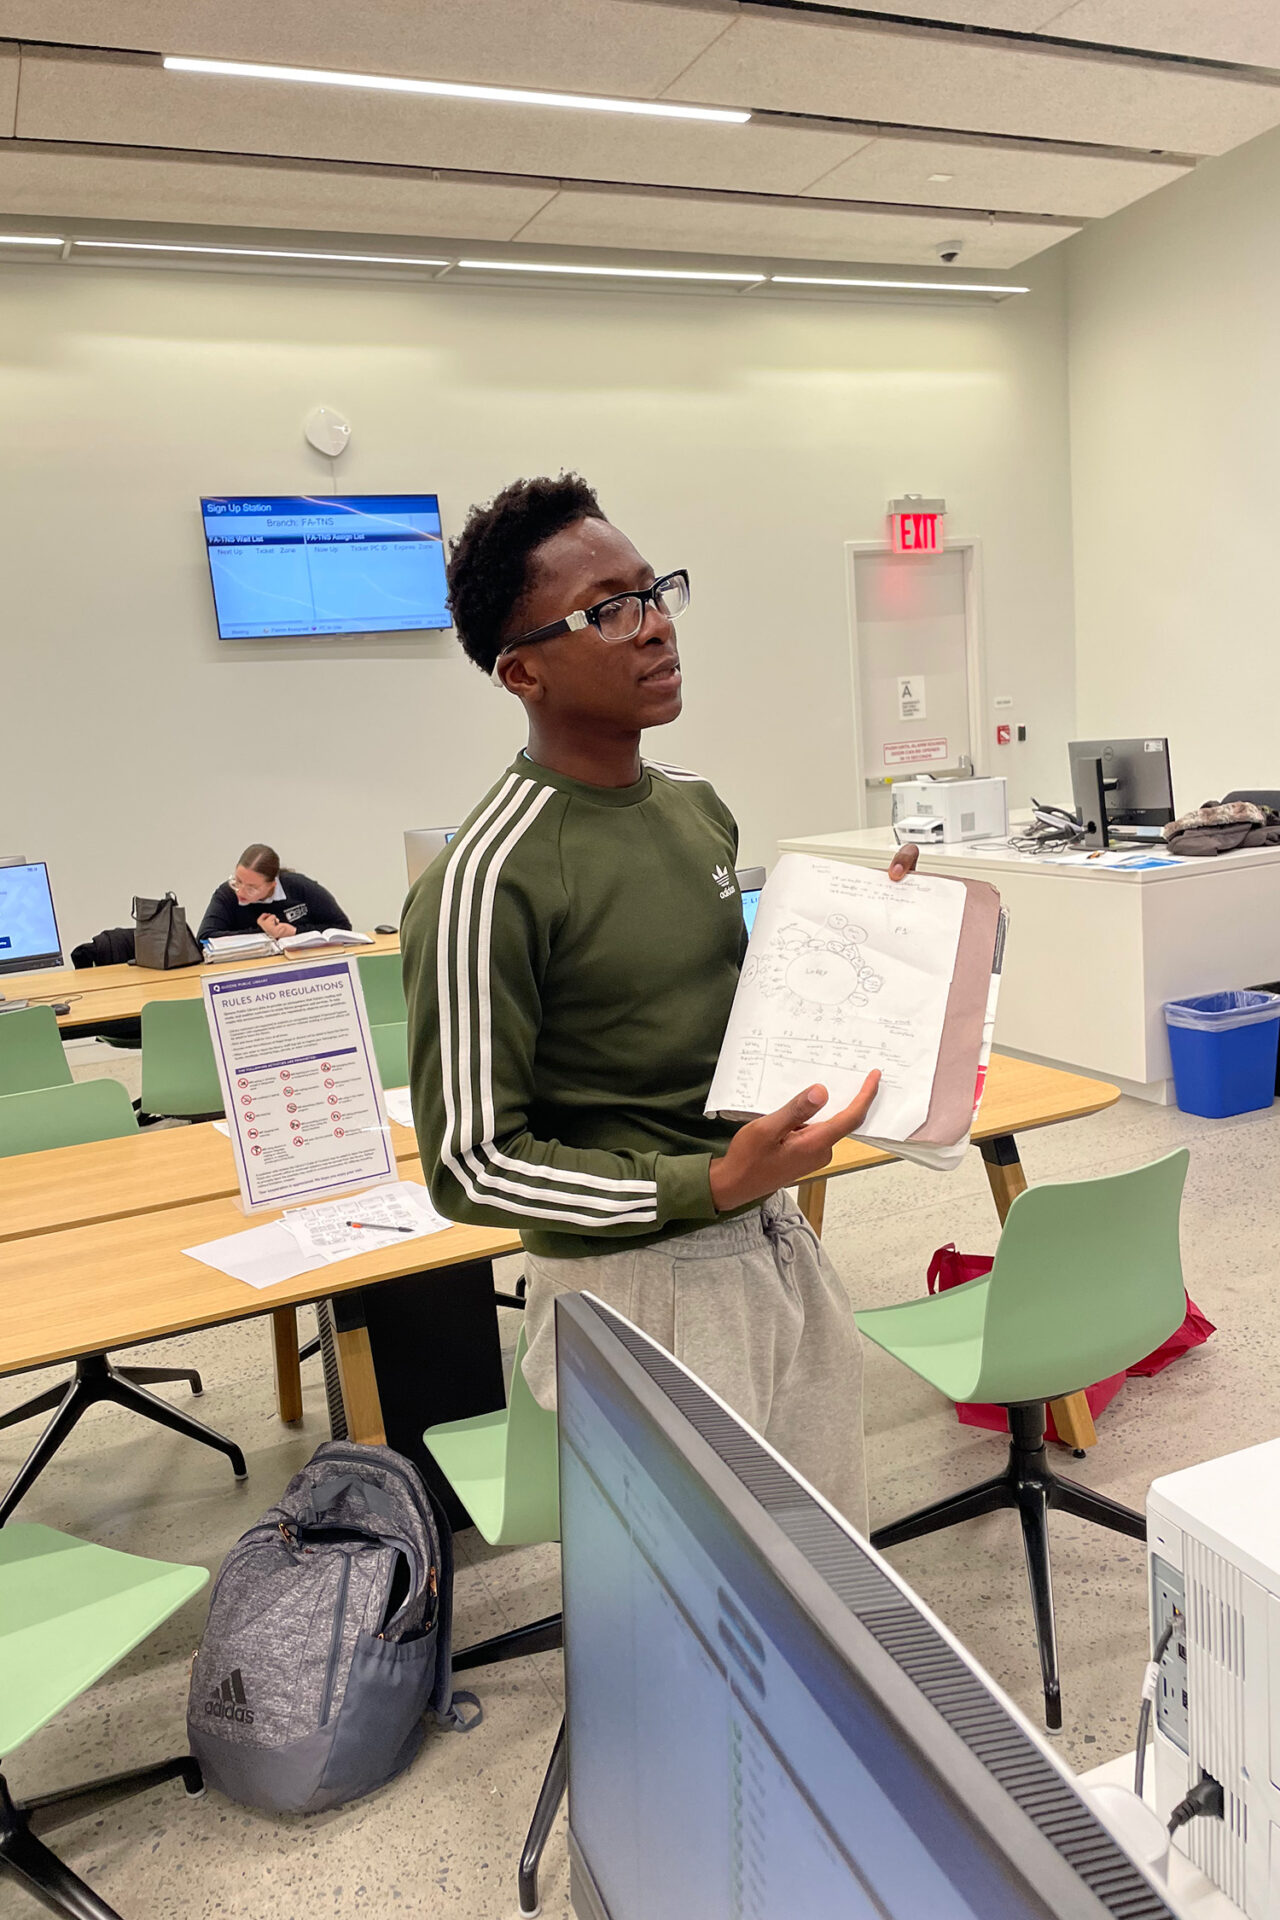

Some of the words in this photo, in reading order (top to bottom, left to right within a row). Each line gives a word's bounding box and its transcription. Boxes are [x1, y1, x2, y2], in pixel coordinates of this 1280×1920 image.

[207, 503, 226, 514] Sign
[228, 504, 241, 514] Up
[242, 503, 272, 512] Station
[266, 519, 298, 527] Branch:
[302, 518, 334, 527] FA-TNS
[901, 514, 937, 550] EXIT
[902, 686, 912, 698] A
[720, 886, 736, 899] adidas
[222, 996, 252, 1008] RULES
[255, 992, 277, 1002] AND
[279, 981, 344, 999] REGULATIONS
[204, 1699, 254, 1724] adidas
